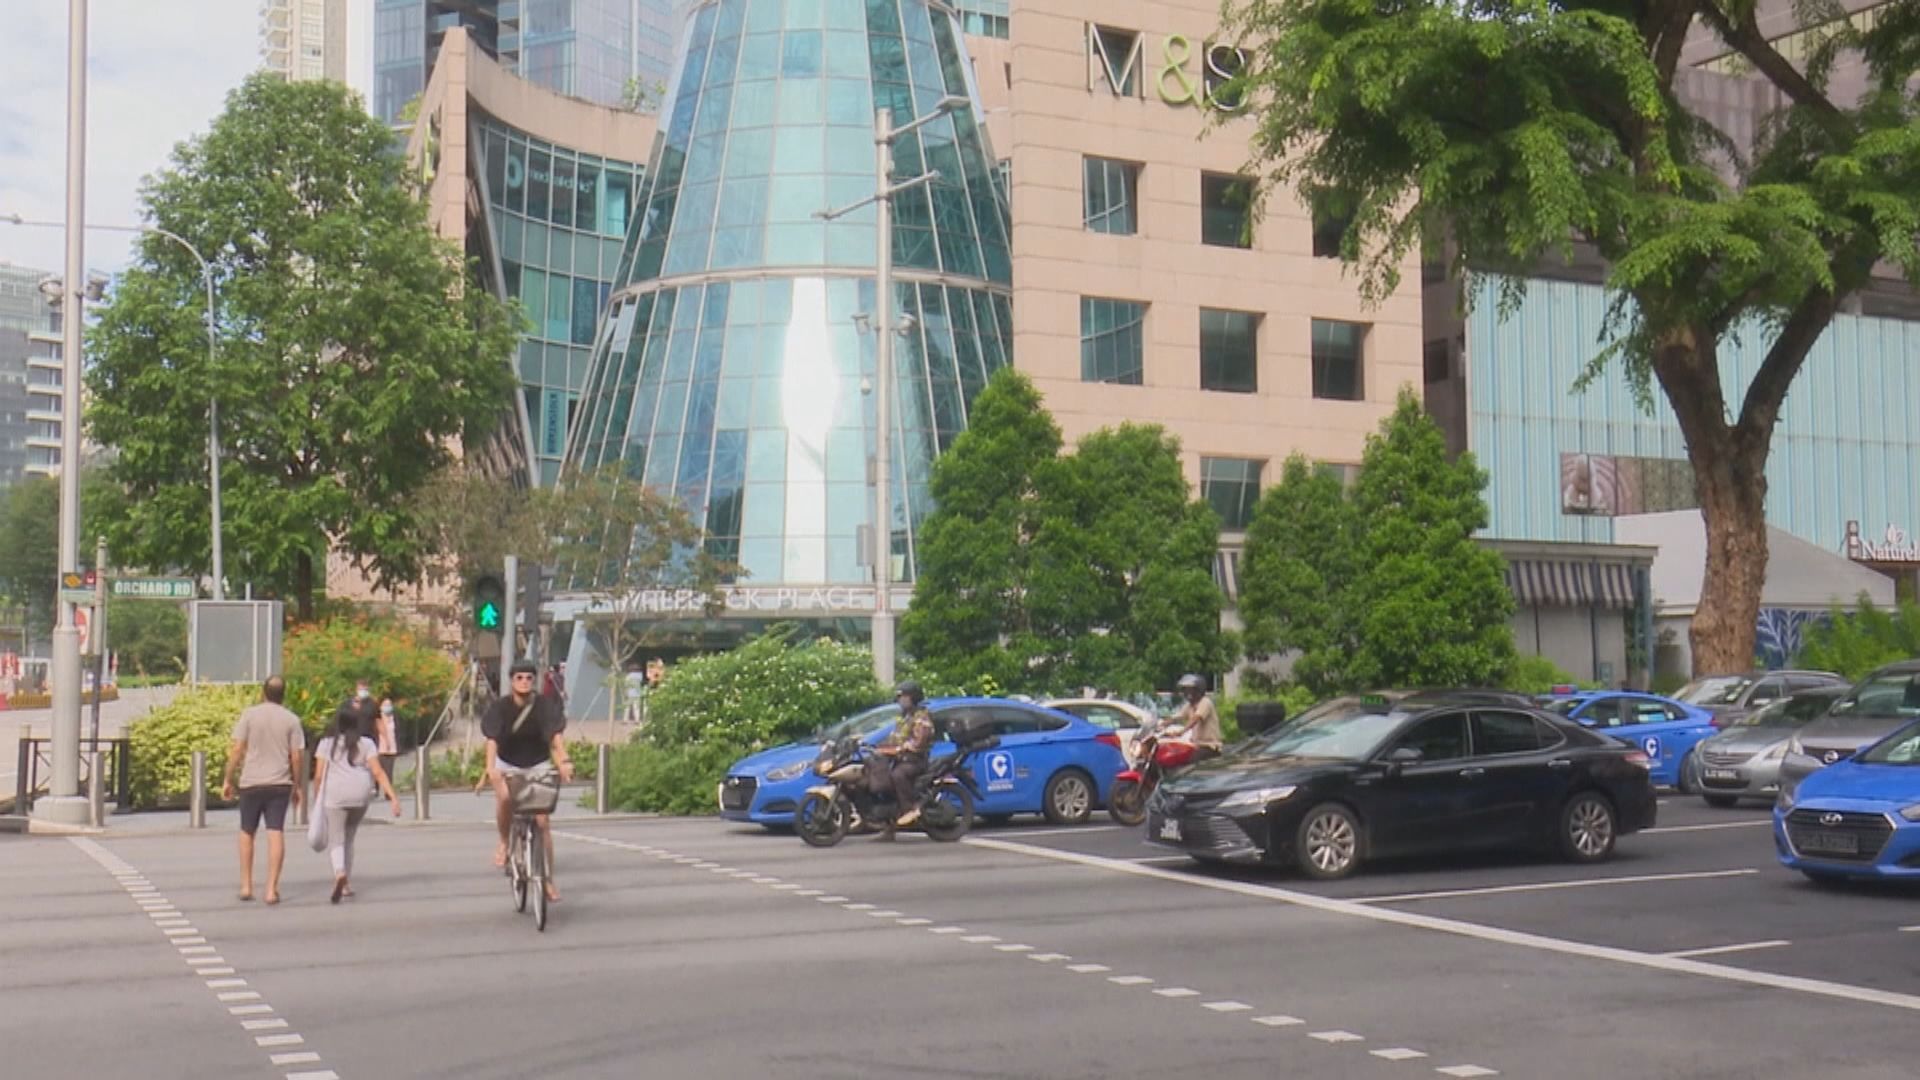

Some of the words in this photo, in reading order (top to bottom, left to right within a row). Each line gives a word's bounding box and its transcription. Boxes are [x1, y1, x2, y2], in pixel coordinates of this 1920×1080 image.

[1085, 22, 1248, 111] M&S
[114, 581, 172, 595] ORCHARD
[174, 582, 191, 596] RD
[777, 586, 864, 610] PLACE
